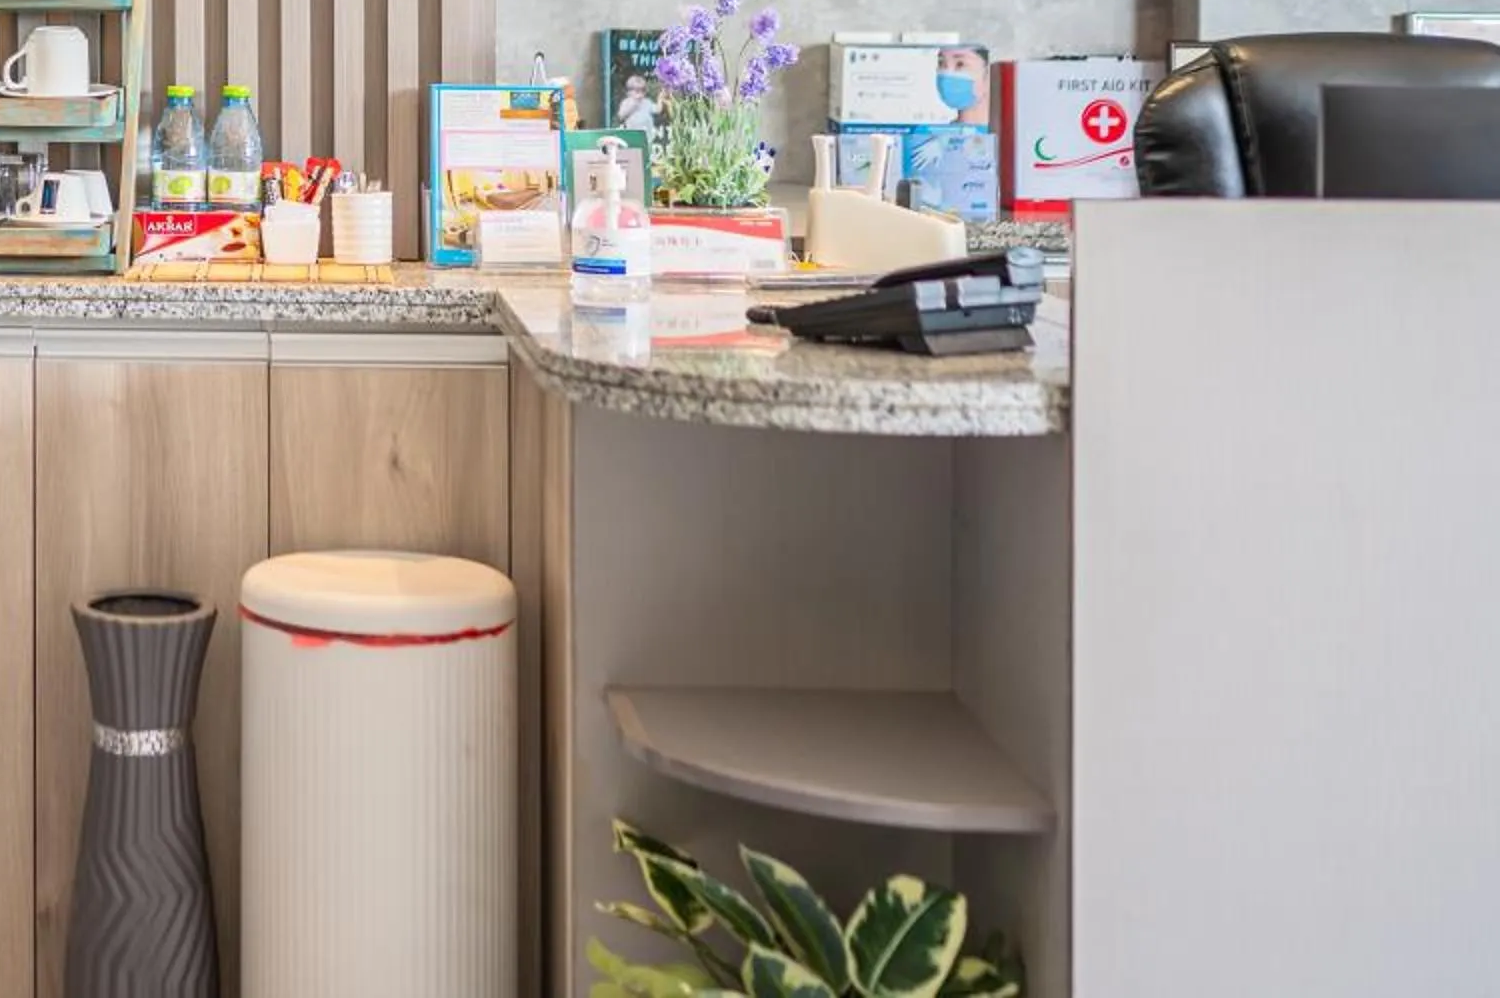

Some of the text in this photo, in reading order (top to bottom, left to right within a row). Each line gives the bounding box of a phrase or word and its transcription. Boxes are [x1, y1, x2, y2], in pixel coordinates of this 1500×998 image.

[1058, 79, 1151, 92] FIRST AID KIT
[147, 220, 193, 232] AKBAR
